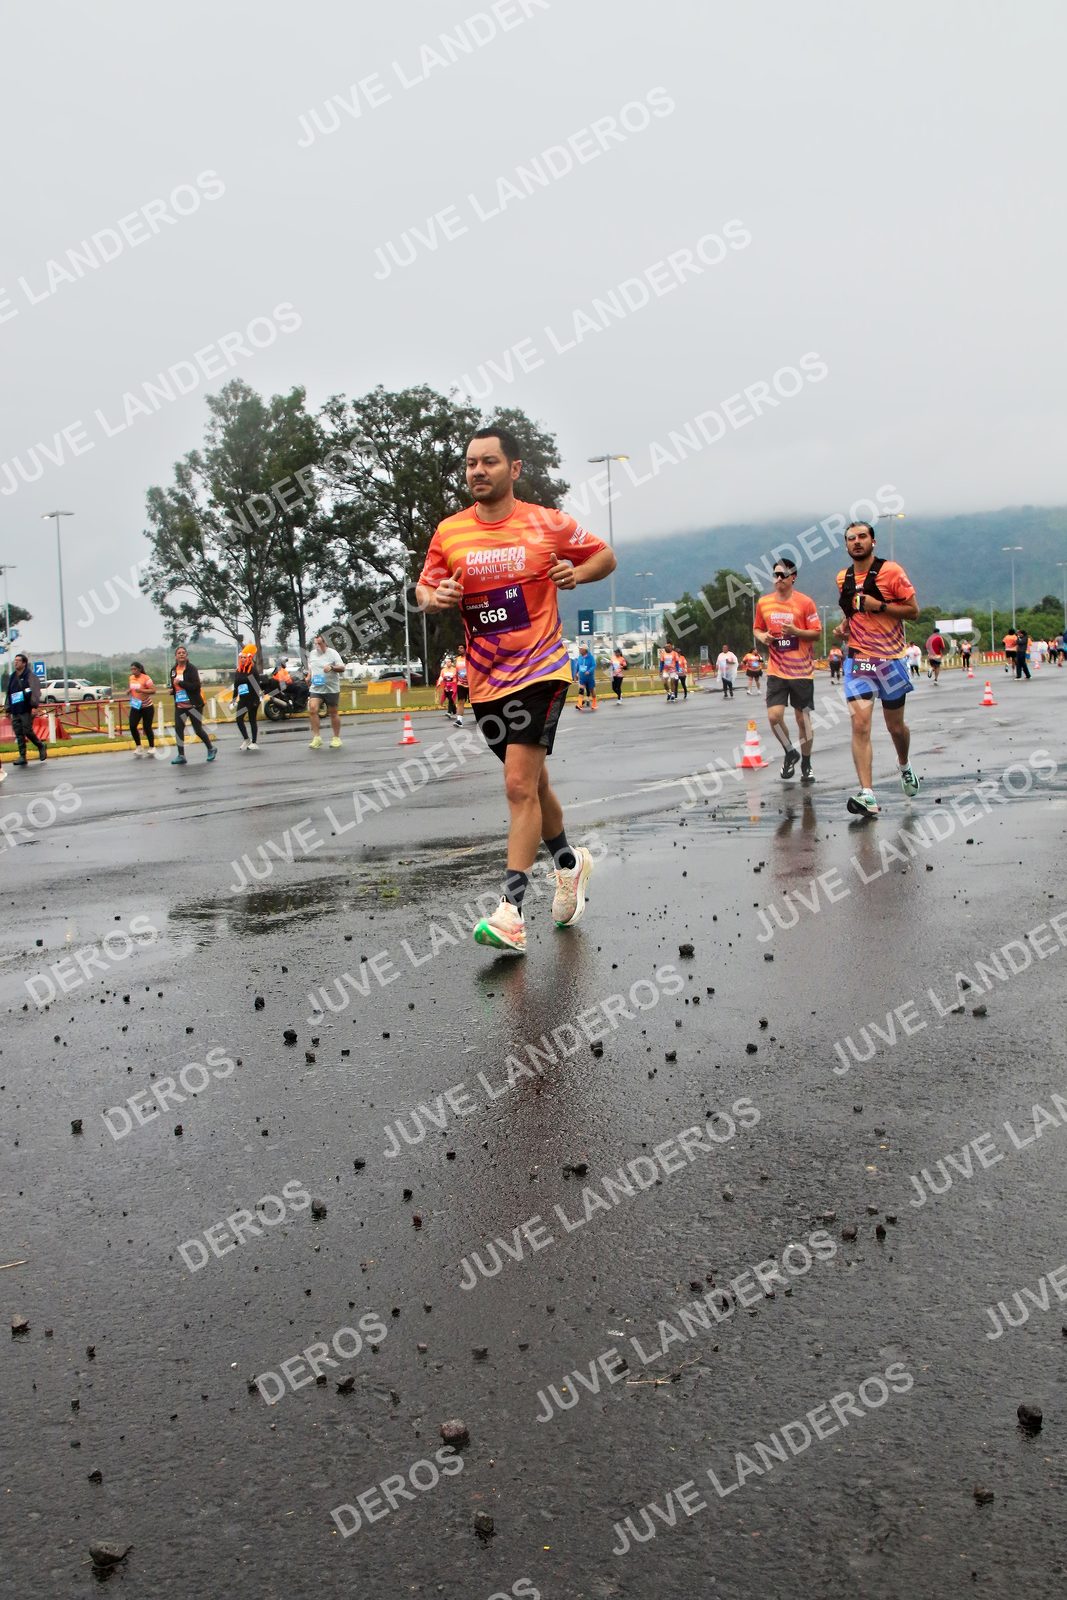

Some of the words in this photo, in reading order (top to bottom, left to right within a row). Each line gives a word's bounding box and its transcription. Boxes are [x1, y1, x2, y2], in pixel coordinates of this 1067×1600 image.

[466, 546, 526, 565] CARRERA
[467, 563, 513, 576] OMNILIFE
[480, 608, 508, 624] 668
[581, 620, 590, 632] E
[860, 663, 877, 672] 594
